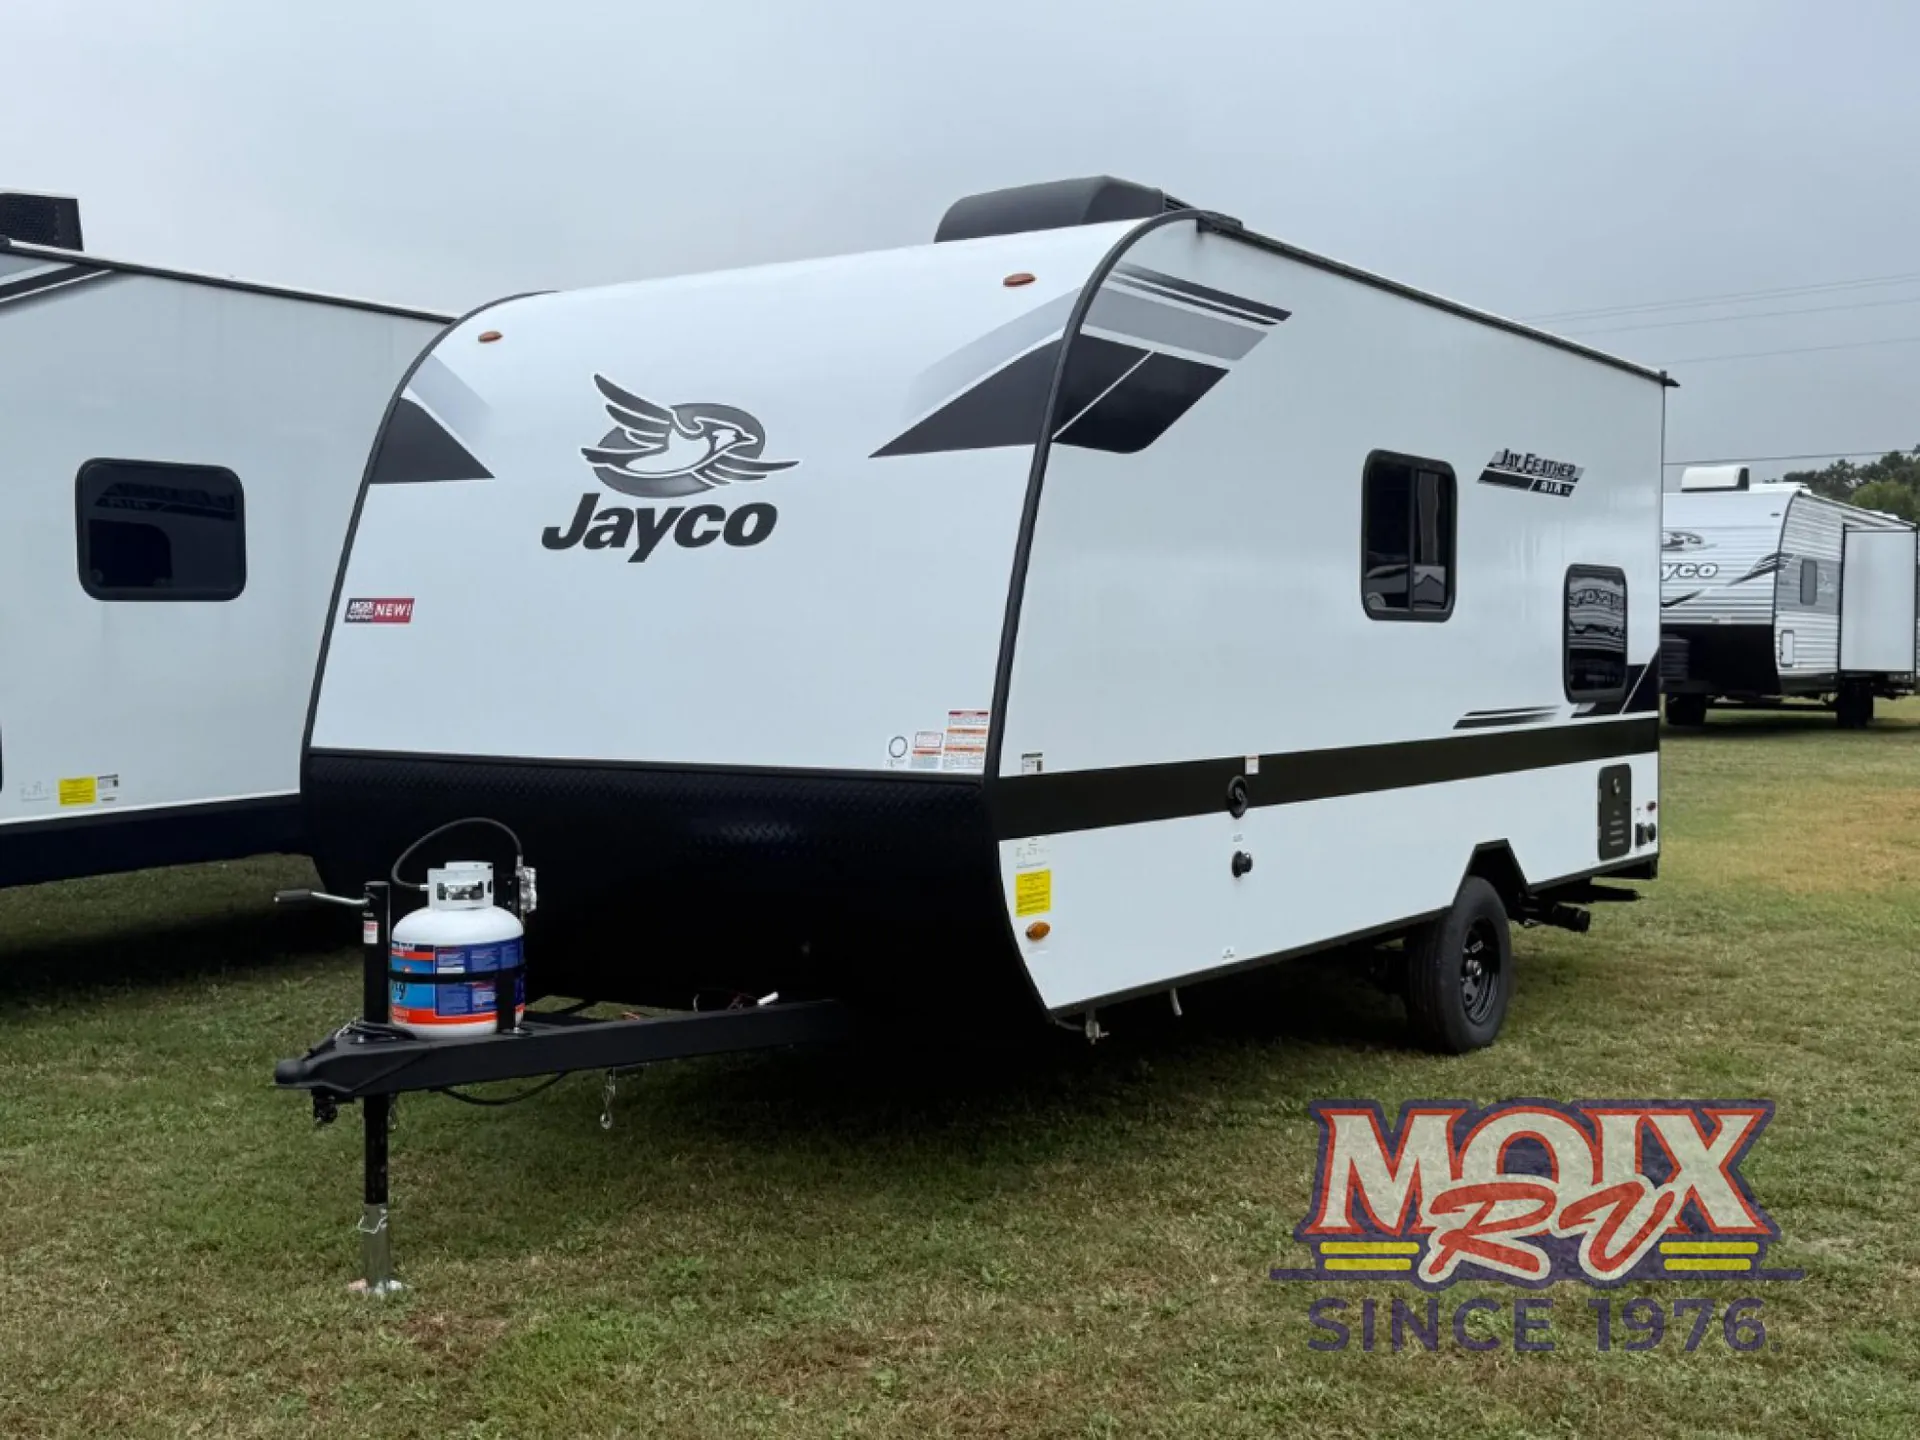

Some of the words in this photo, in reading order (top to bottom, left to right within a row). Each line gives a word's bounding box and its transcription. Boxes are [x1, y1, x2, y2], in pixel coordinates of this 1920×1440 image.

[541, 492, 778, 563] Jayco
[1660, 562, 1719, 582] yco
[374, 603, 412, 617] NEW!
